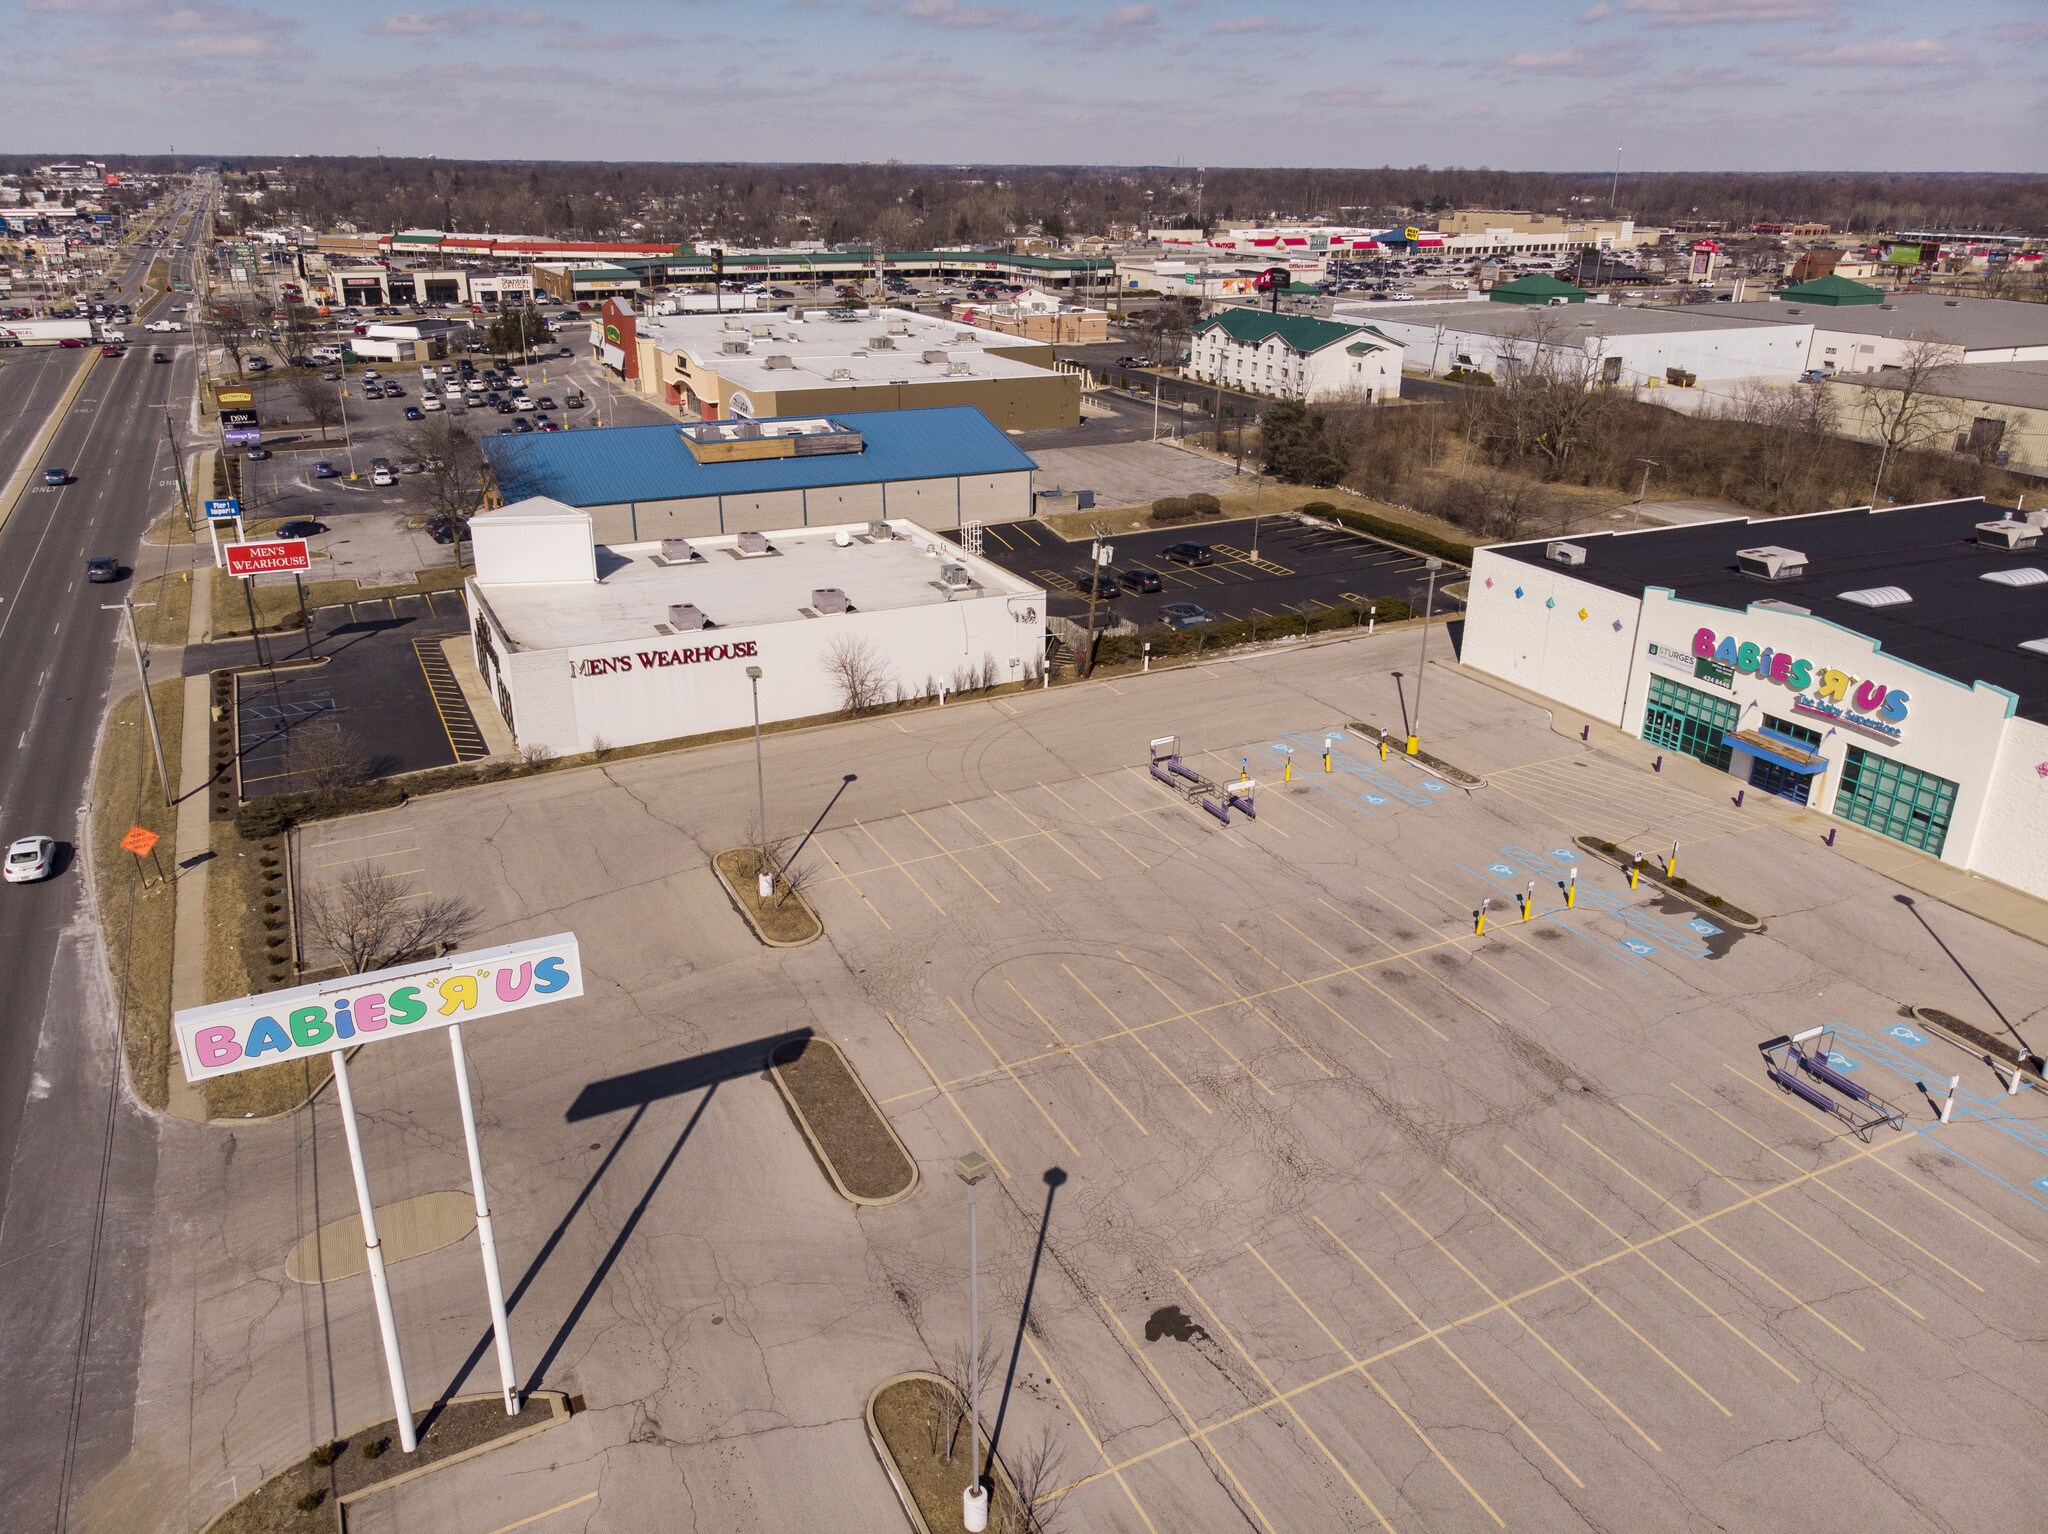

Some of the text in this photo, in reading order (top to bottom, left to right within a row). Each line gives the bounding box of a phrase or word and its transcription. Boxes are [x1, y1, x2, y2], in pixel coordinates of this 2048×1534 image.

[232, 556, 306, 570] WEARHOUSE
[250, 547, 285, 557] MEN'S
[569, 641, 758, 678] MEN'S WEARHOUSE
[1659, 647, 1695, 665] STURGES
[1703, 675, 1714, 683] 424
[1857, 680, 1909, 721] US
[1798, 693, 1901, 736] The Baby Superstore
[496, 956, 570, 1002] US
